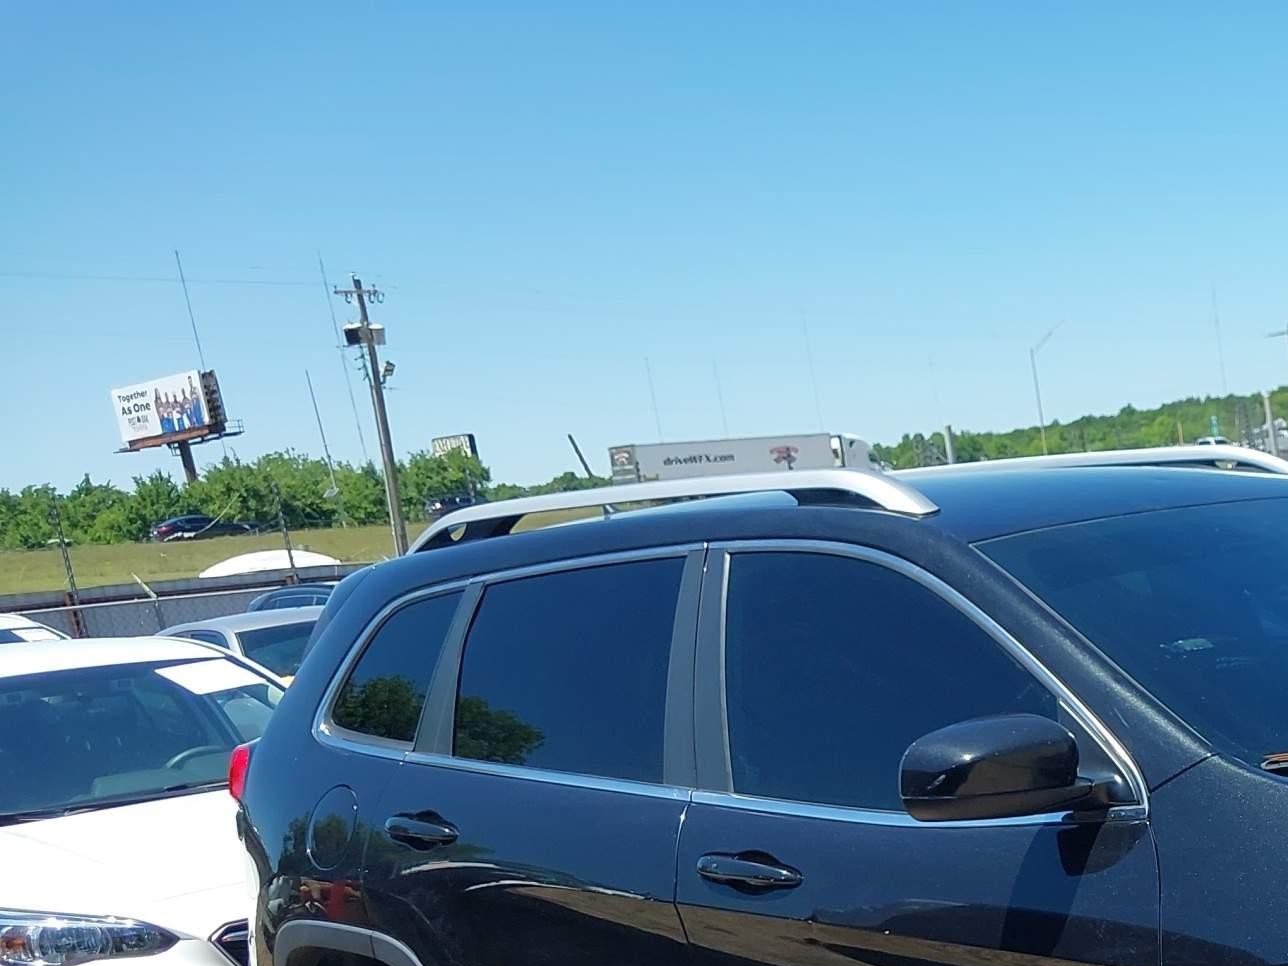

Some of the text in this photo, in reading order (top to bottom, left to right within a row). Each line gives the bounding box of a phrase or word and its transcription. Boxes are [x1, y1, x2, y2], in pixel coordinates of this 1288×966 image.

[117, 390, 147, 403] Together
[121, 401, 151, 417] As One
